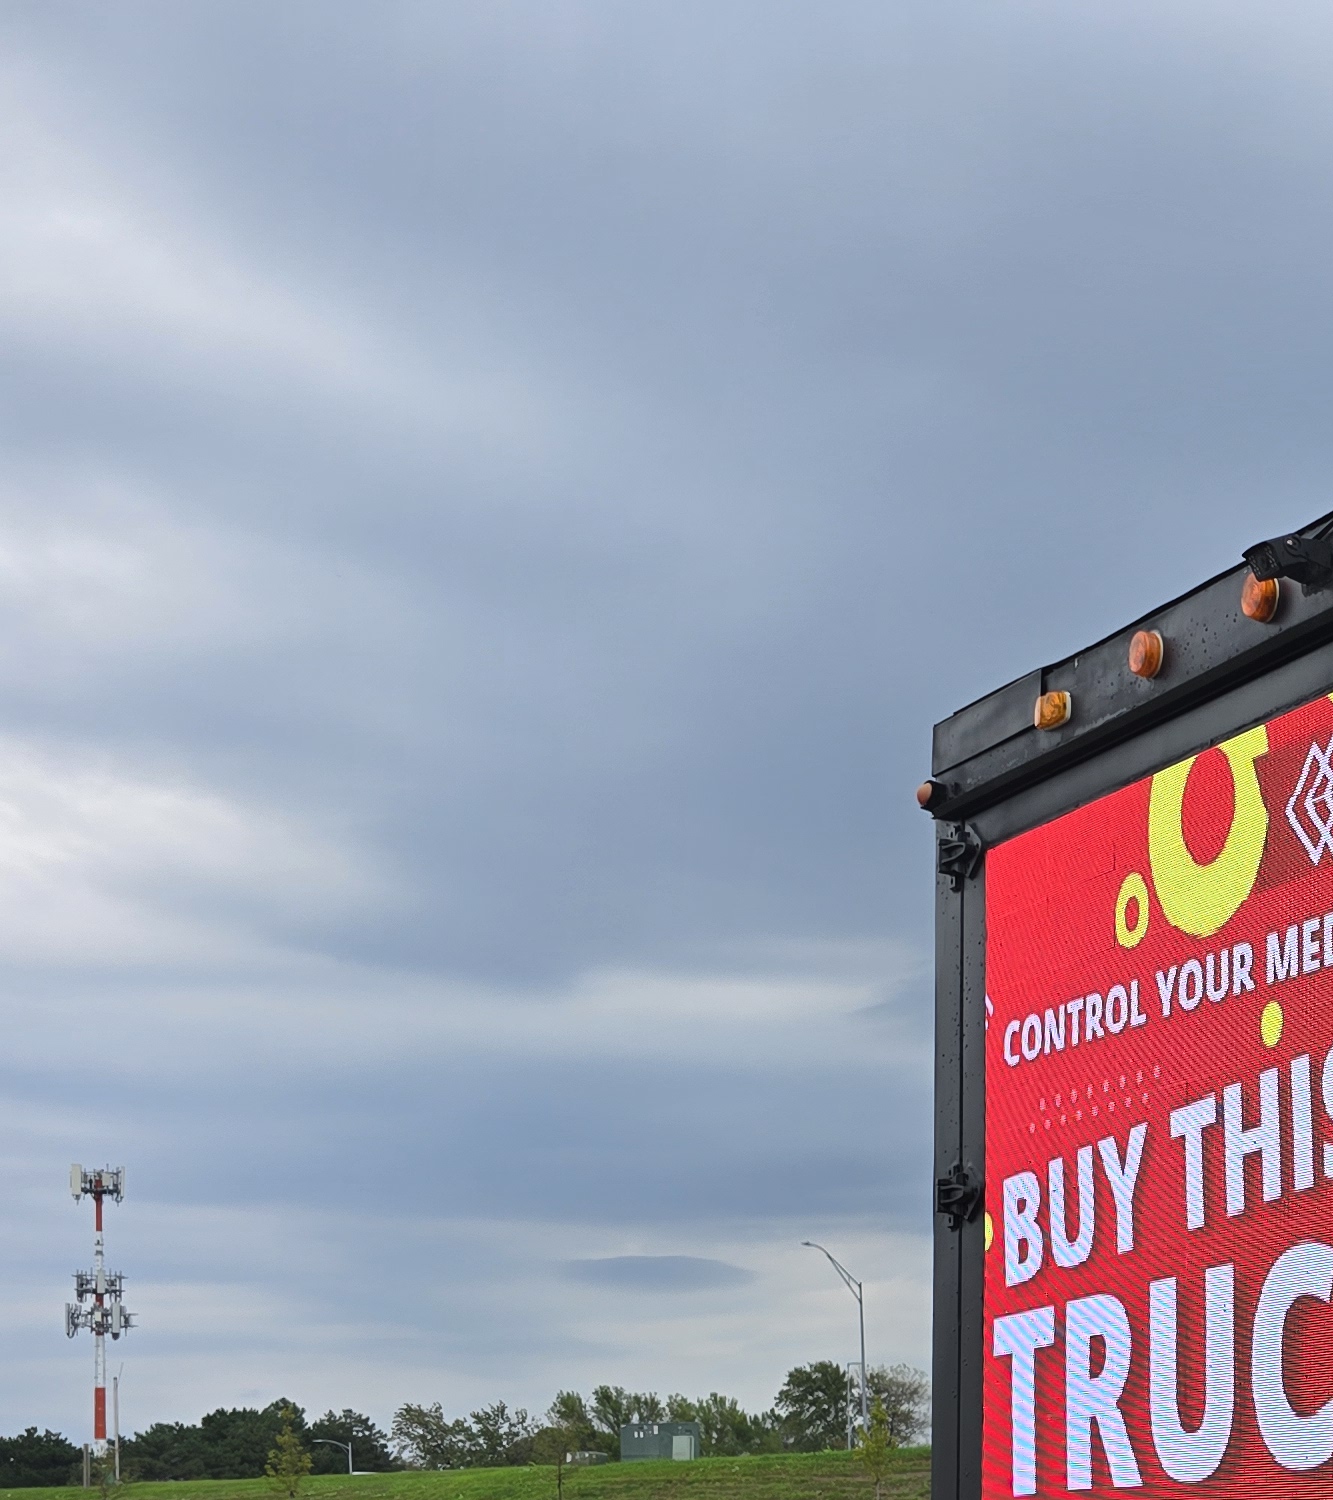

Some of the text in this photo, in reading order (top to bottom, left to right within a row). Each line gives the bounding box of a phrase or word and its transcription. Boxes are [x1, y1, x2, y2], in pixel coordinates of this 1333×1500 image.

[1002, 981, 1148, 1068] CONTROL
[1155, 939, 1256, 1019] YOUR
[1002, 1121, 1149, 1289] BUY
